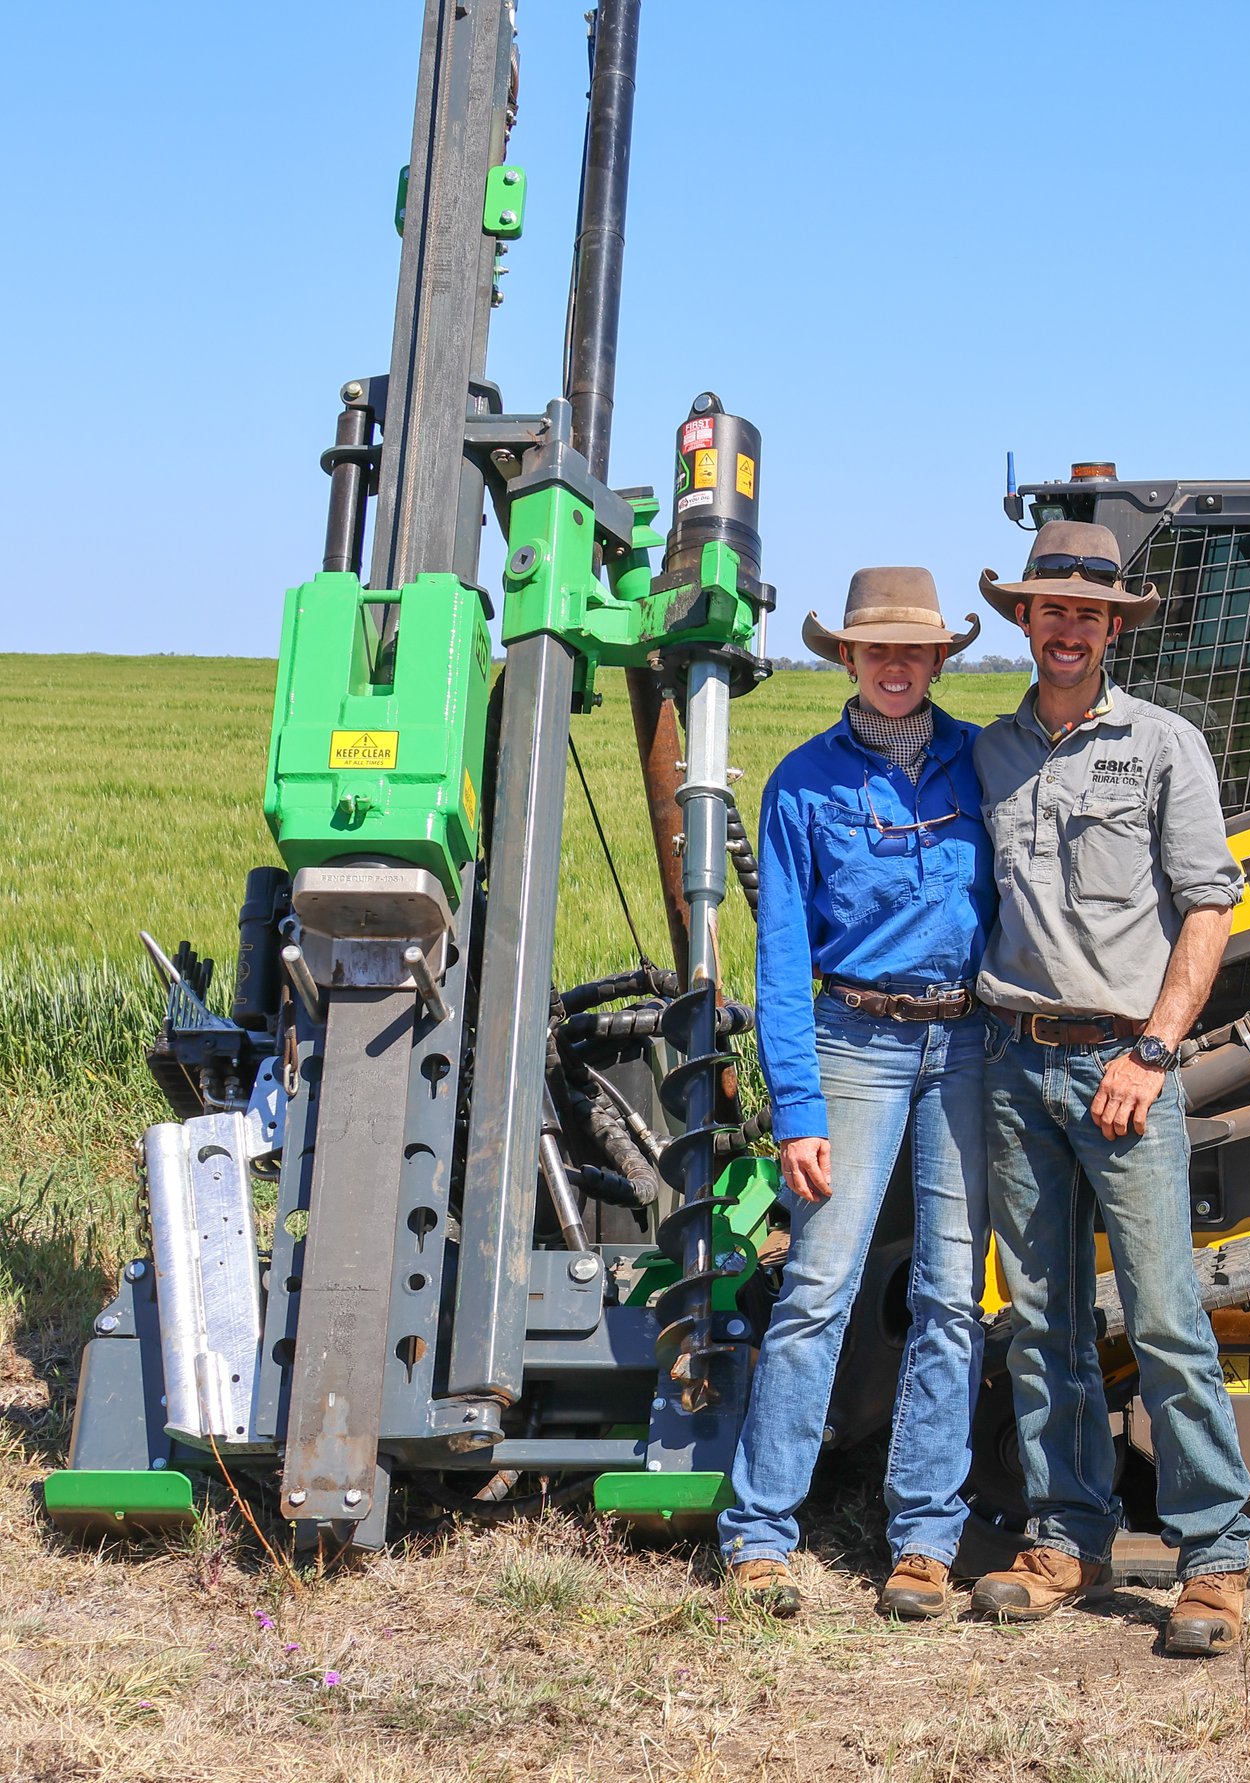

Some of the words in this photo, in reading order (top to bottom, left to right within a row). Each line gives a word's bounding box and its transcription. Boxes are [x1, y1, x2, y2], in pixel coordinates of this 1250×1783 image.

[685, 419, 710, 431] FIRST
[336, 748, 360, 758] KEEP
[362, 748, 391, 758] CLEAR
[1092, 774, 1119, 784] RURAL
